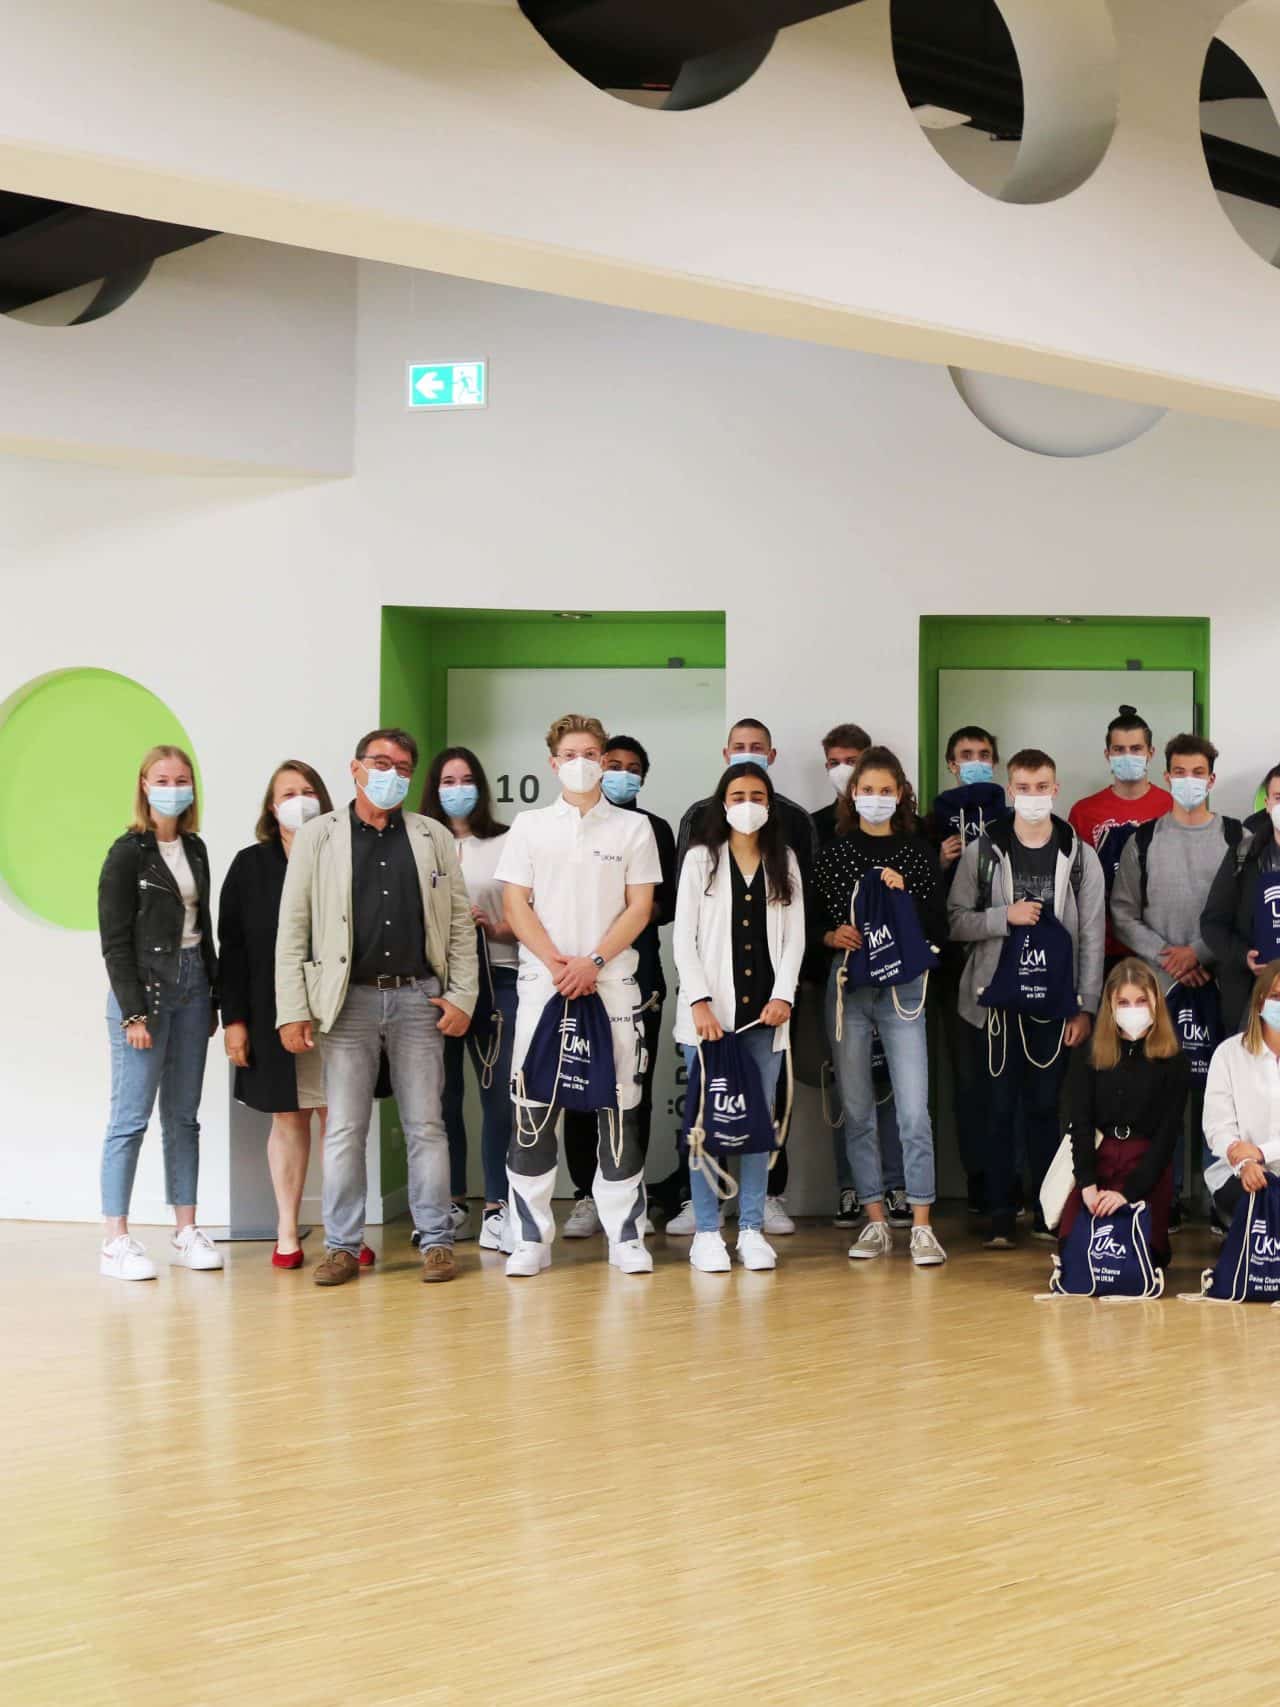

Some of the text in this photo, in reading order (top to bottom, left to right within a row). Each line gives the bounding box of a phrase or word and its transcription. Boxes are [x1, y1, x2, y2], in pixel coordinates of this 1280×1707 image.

[497, 774, 540, 803] 10
[1183, 1023, 1211, 1041] UKM
[563, 1033, 591, 1058] UKM
